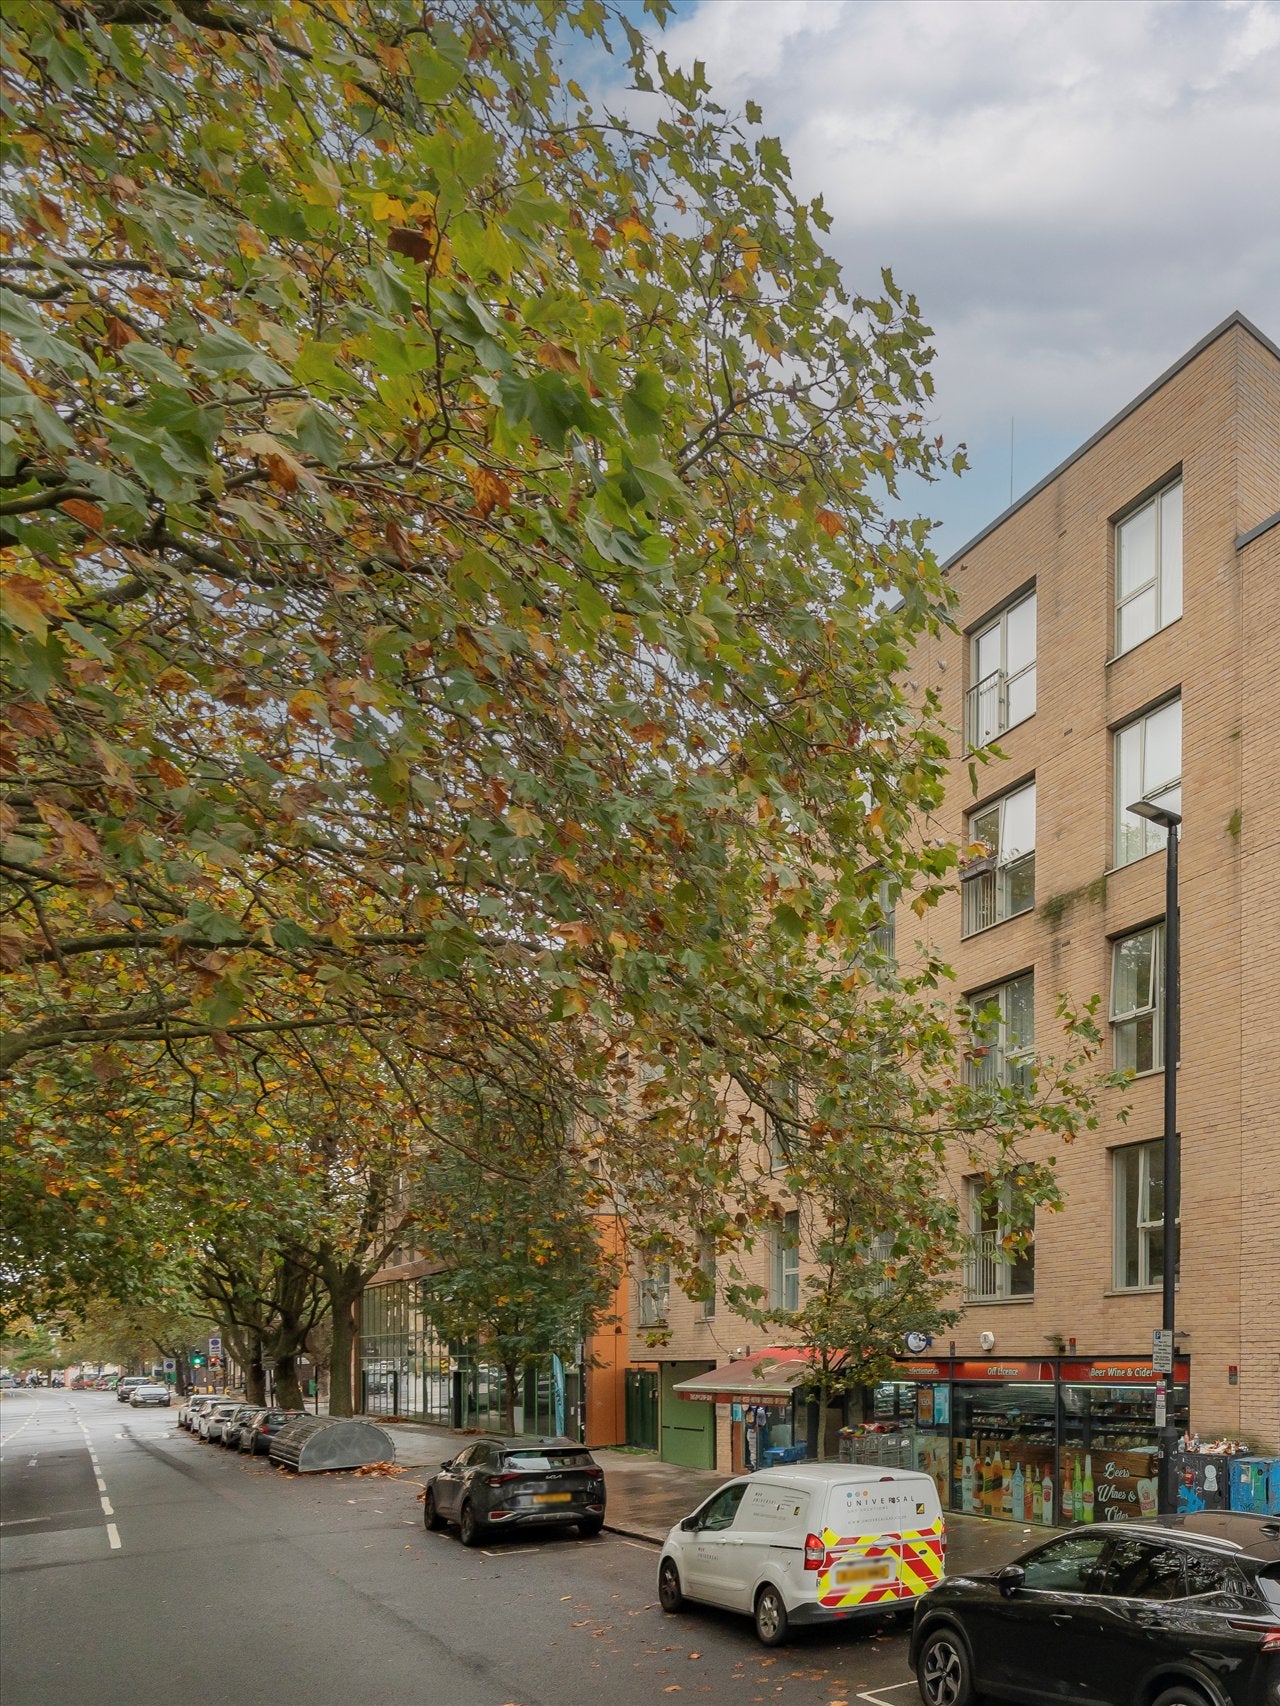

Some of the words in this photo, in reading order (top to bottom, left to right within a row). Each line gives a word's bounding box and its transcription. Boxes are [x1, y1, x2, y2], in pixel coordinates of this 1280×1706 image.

[987, 1367, 996, 1376] Off
[997, 1367, 1019, 1376] Licence
[1090, 1367, 1106, 1377] Beer
[1107, 1367, 1125, 1377] Wine
[1126, 1367, 1133, 1377] &
[1134, 1367, 1153, 1377] Cider
[1103, 1461, 1130, 1479] Beers
[1097, 1484, 1127, 1502] Wines
[1127, 1490, 1137, 1503] &
[846, 1496, 915, 1508] UNIVERSAL
[1104, 1506, 1129, 1521] Cider
